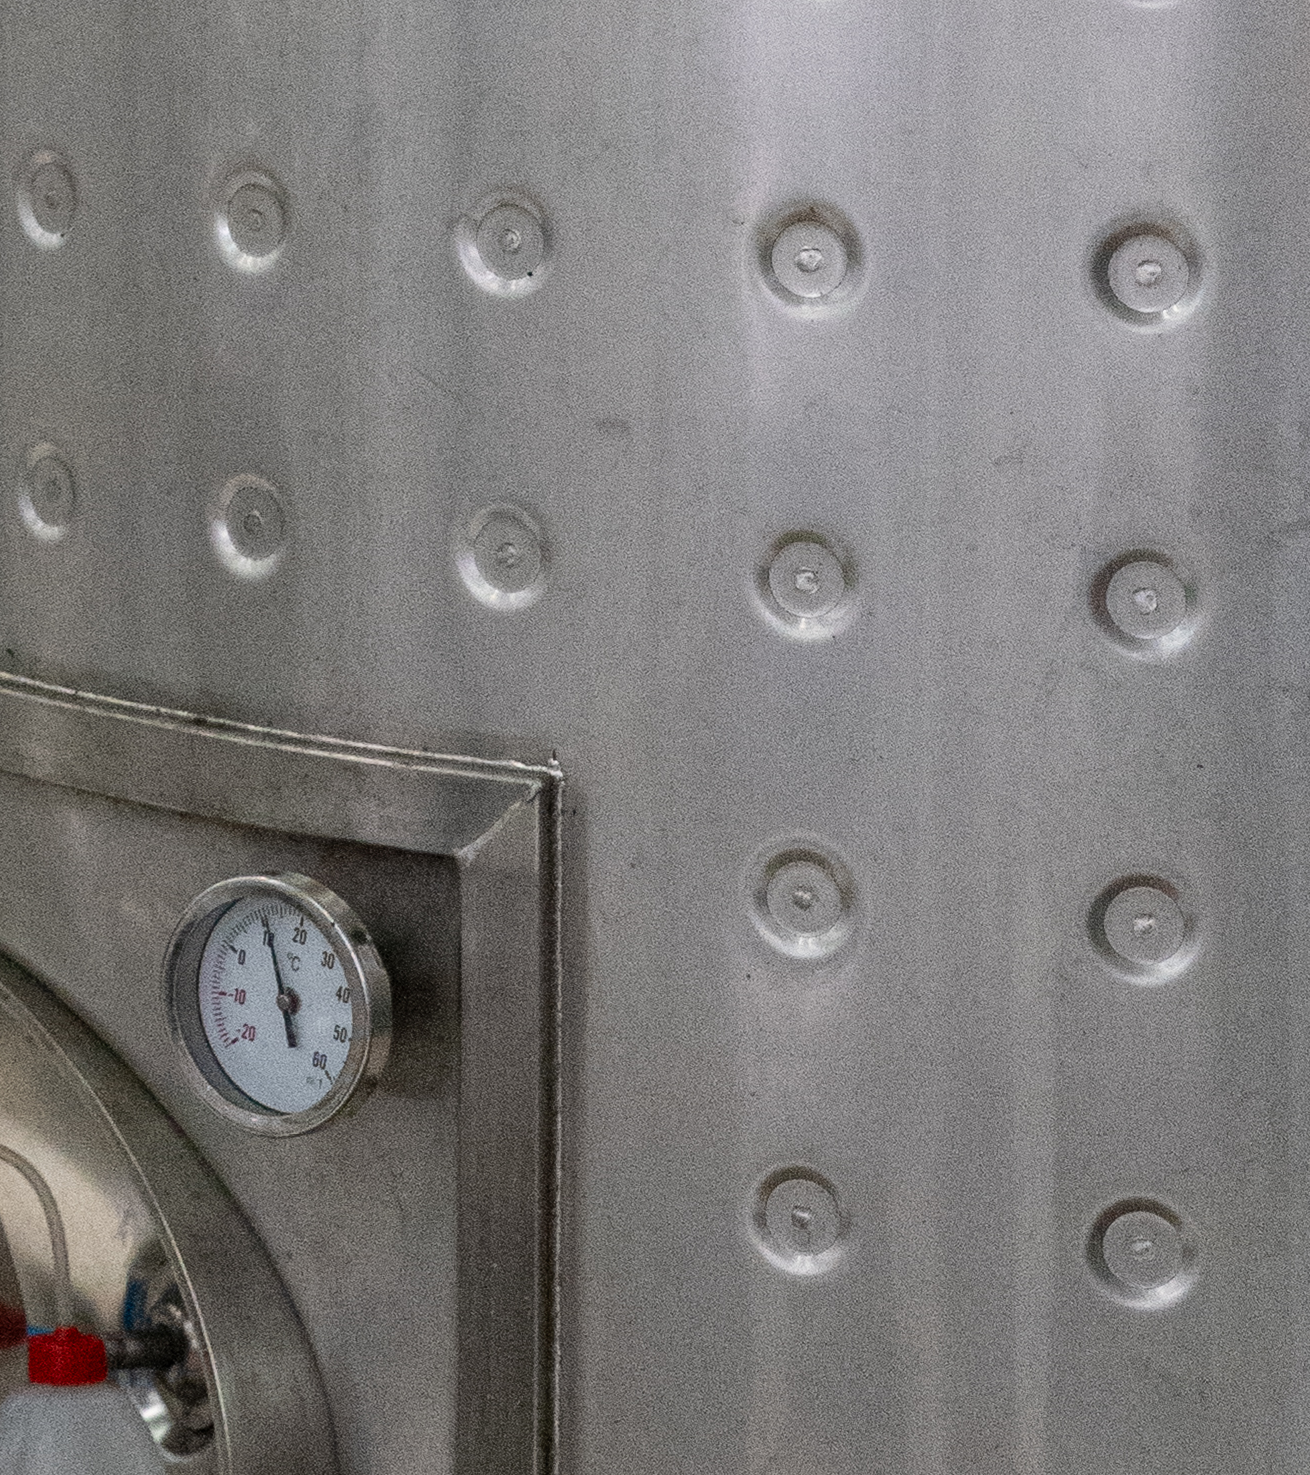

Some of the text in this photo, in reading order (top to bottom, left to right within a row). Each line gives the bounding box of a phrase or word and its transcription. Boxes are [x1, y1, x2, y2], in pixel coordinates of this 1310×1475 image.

[292, 927, 308, 945] 20
[238, 950, 247, 966] 0
[321, 950, 335, 969] 30
[336, 987, 351, 1003] 40
[333, 1024, 347, 1043] 50
[312, 1051, 328, 1070] 60
